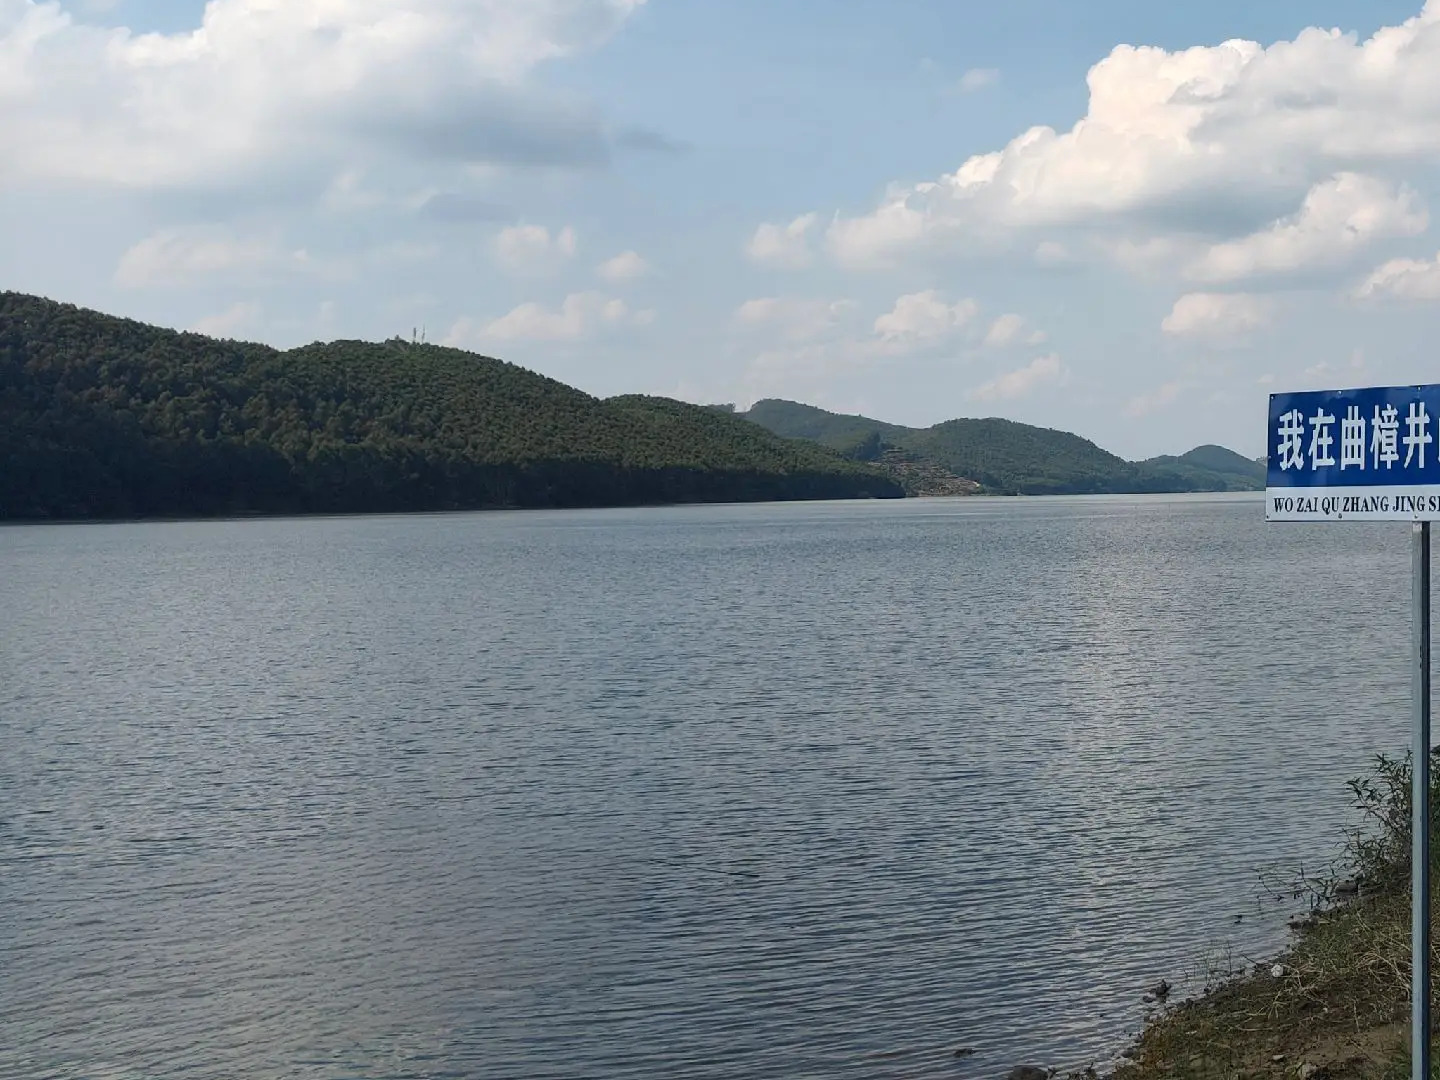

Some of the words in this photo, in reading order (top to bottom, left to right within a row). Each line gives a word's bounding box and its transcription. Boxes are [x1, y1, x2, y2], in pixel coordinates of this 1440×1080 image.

[1274, 497, 1294, 513] WO
[1296, 497, 1319, 513] ZAI
[1321, 497, 1340, 515] QU
[1342, 496, 1390, 513] ZHANG
[1392, 496, 1426, 512] JING
